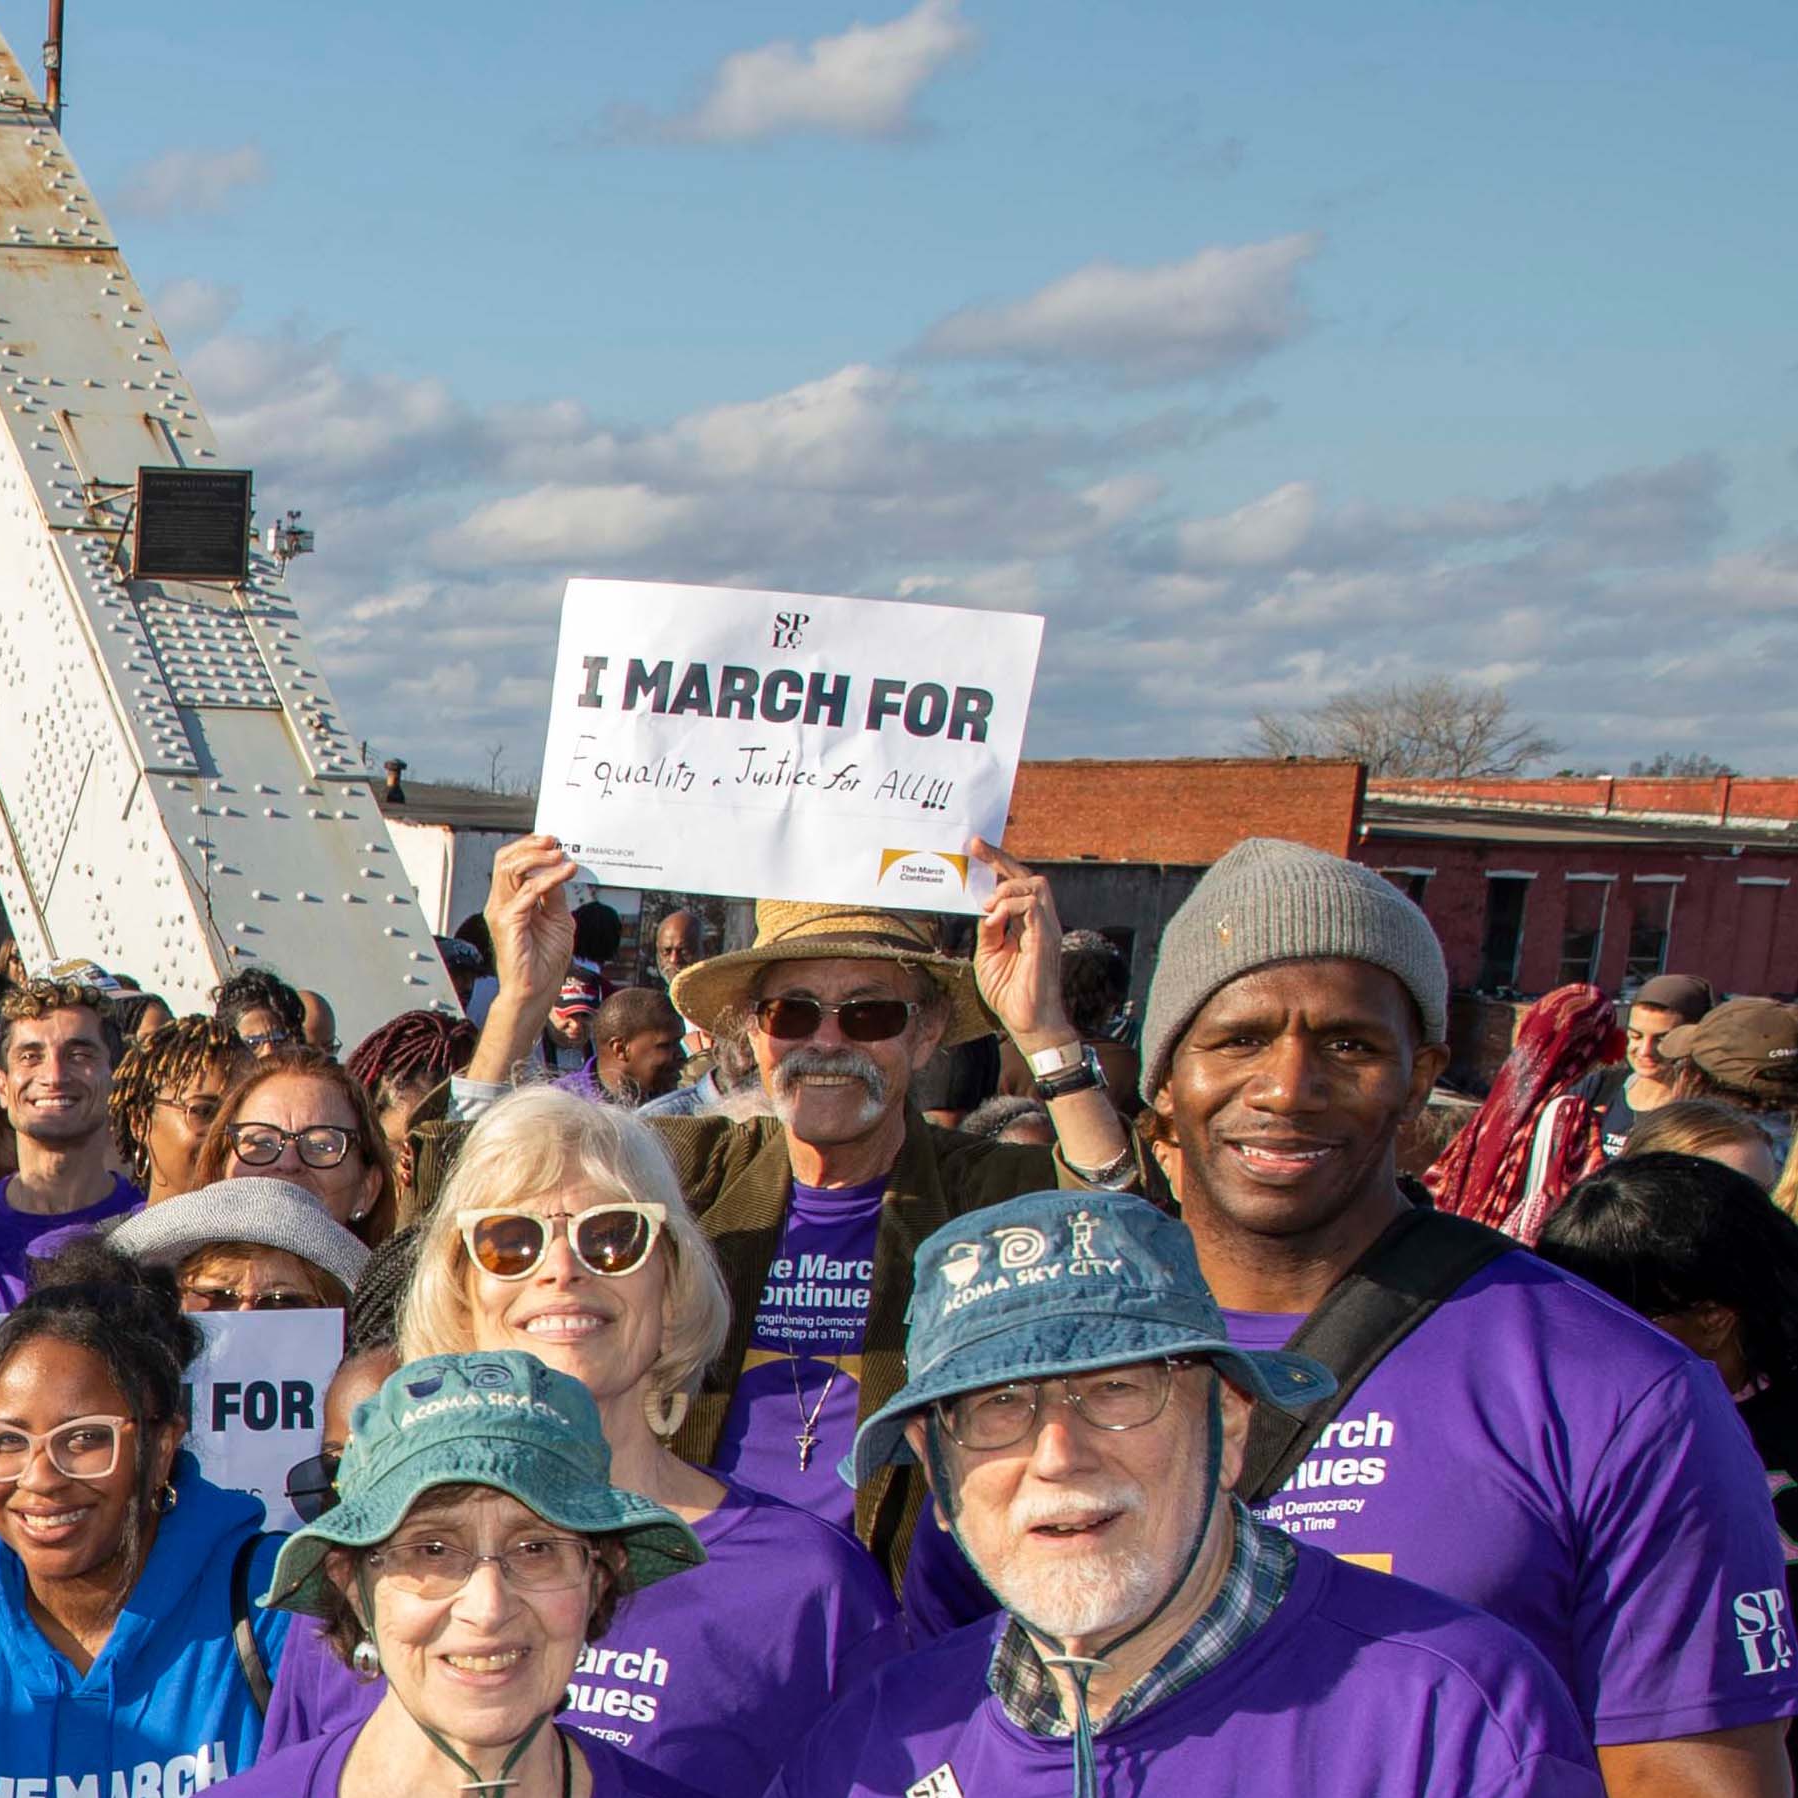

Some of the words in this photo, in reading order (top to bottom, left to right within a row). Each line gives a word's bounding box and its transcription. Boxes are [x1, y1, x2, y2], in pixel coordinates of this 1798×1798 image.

[578, 655, 609, 708] I
[621, 658, 851, 727] MARCH
[865, 678, 994, 743] FOR
[735, 746, 819, 787] Justice
[942, 1275, 1011, 1317] ACOMA
[1016, 1264, 1062, 1287] SKY
[1068, 1259, 1123, 1276] CITY
[211, 1380, 315, 1432] FOR
[400, 1392, 480, 1428] ACOMA
[1285, 1498, 1365, 1517] Democracy
[1303, 1517, 1336, 1531] Time
